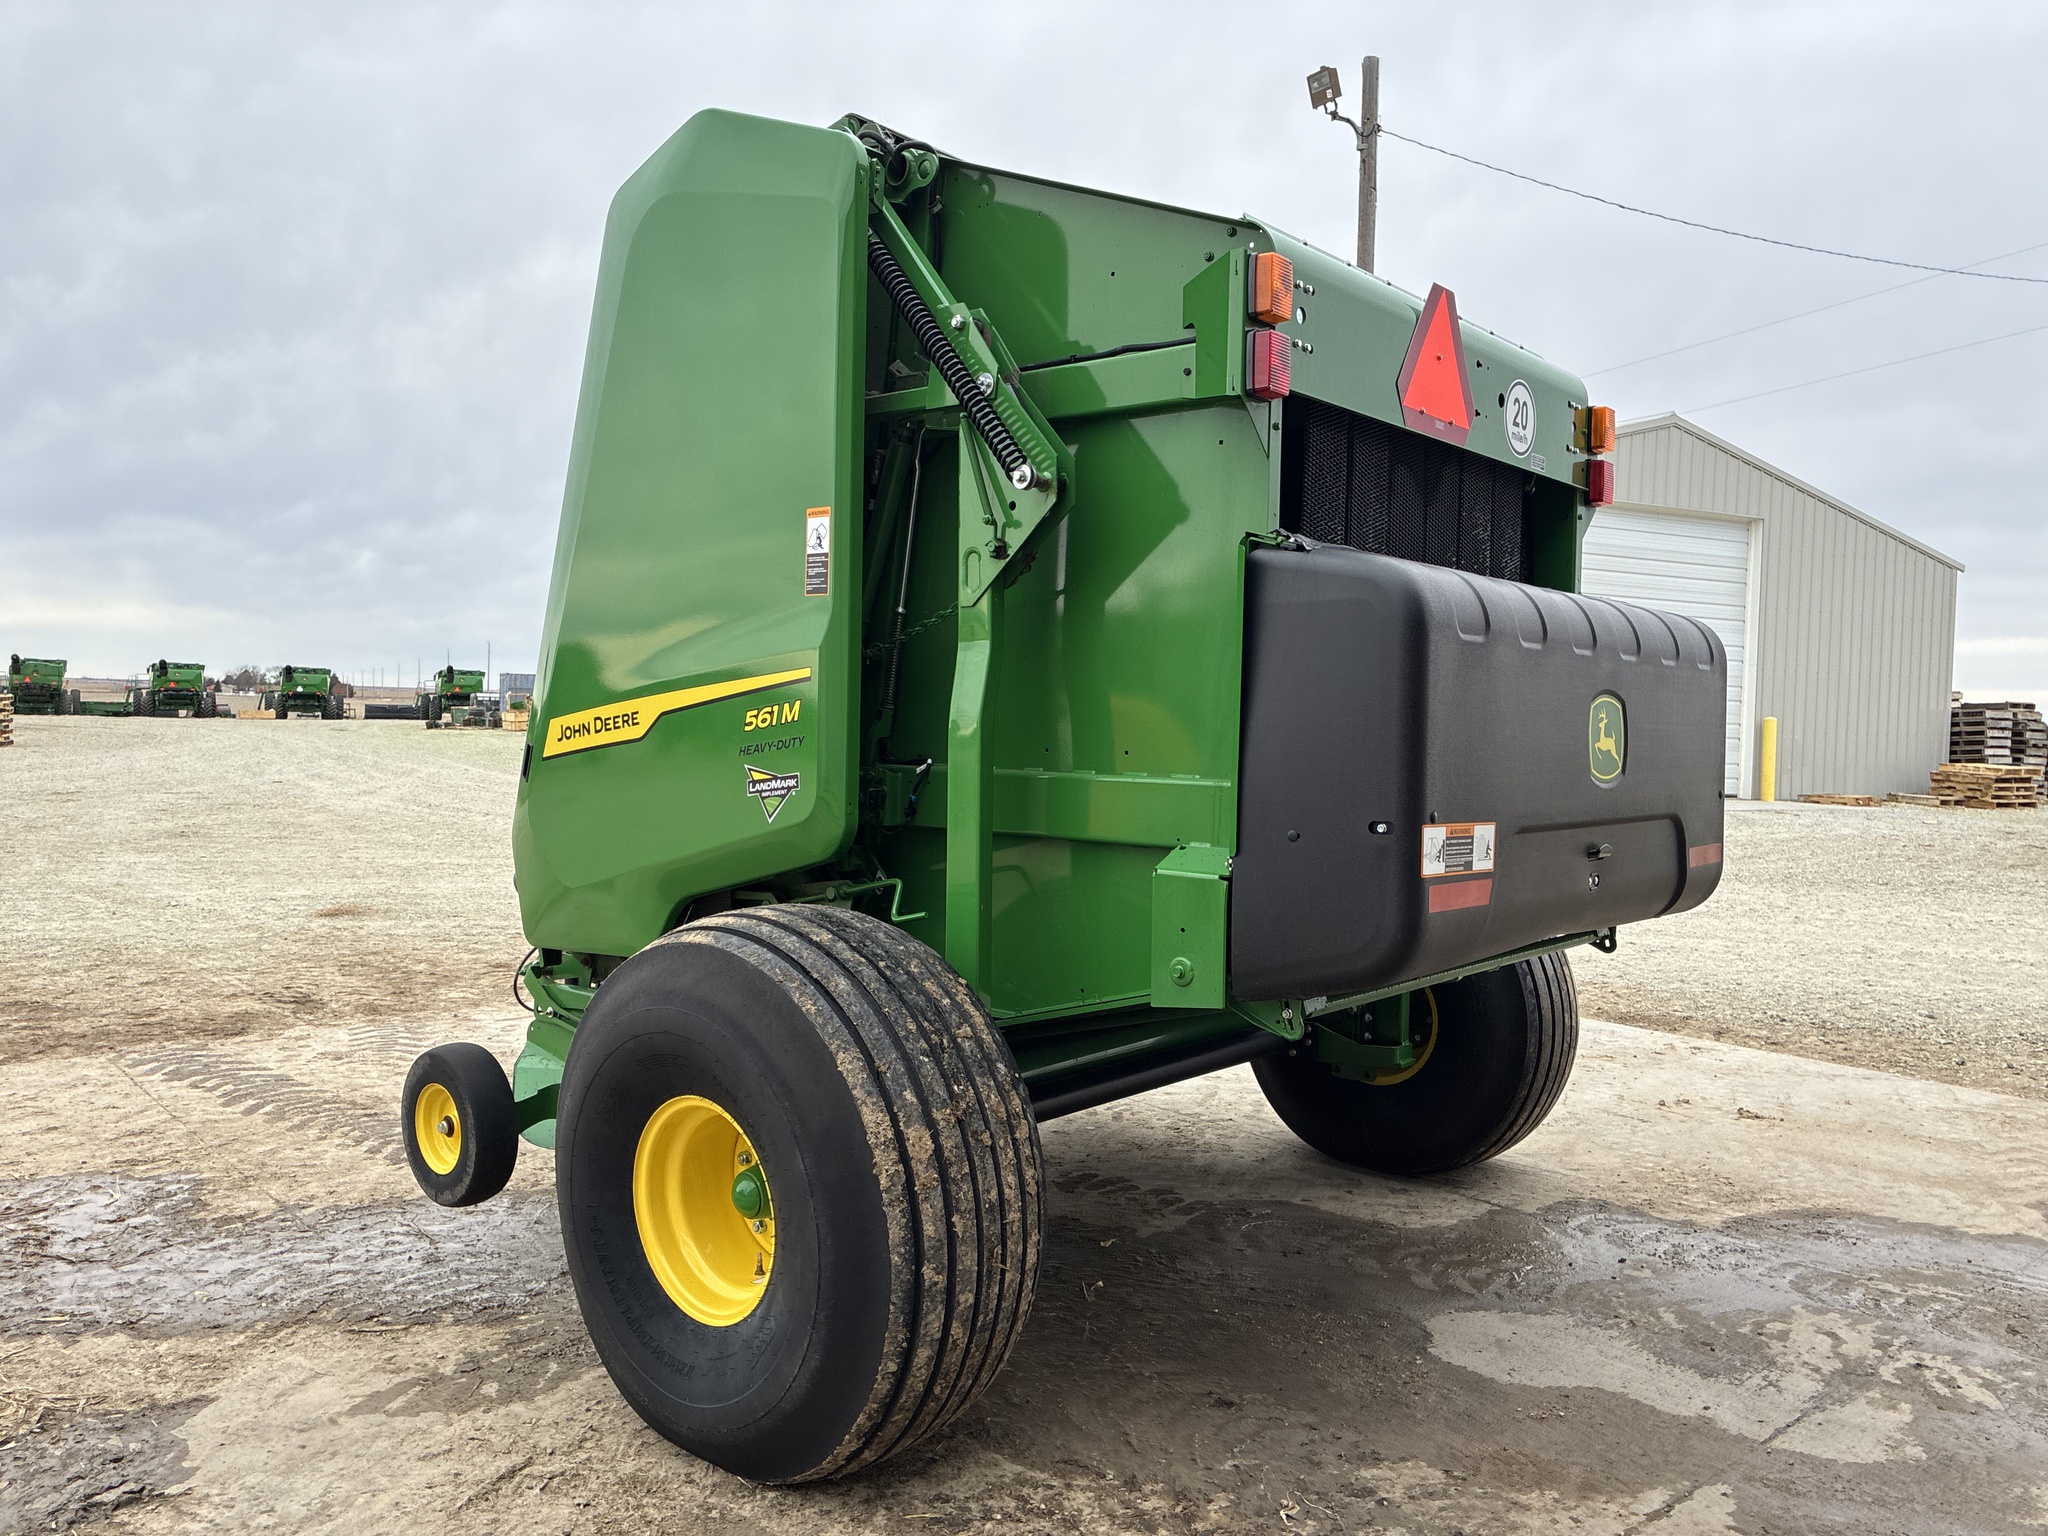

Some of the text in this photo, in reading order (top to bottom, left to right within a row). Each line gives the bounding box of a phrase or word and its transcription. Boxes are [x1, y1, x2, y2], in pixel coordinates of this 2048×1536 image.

[1512, 397, 1528, 431] 20
[1511, 431, 1528, 445] mile/h
[557, 710, 640, 742] JOHN DEERE
[743, 706, 778, 733] 561
[738, 735, 805, 757] HEAVY-DUTY
[749, 778, 797, 792] LANDMARK
